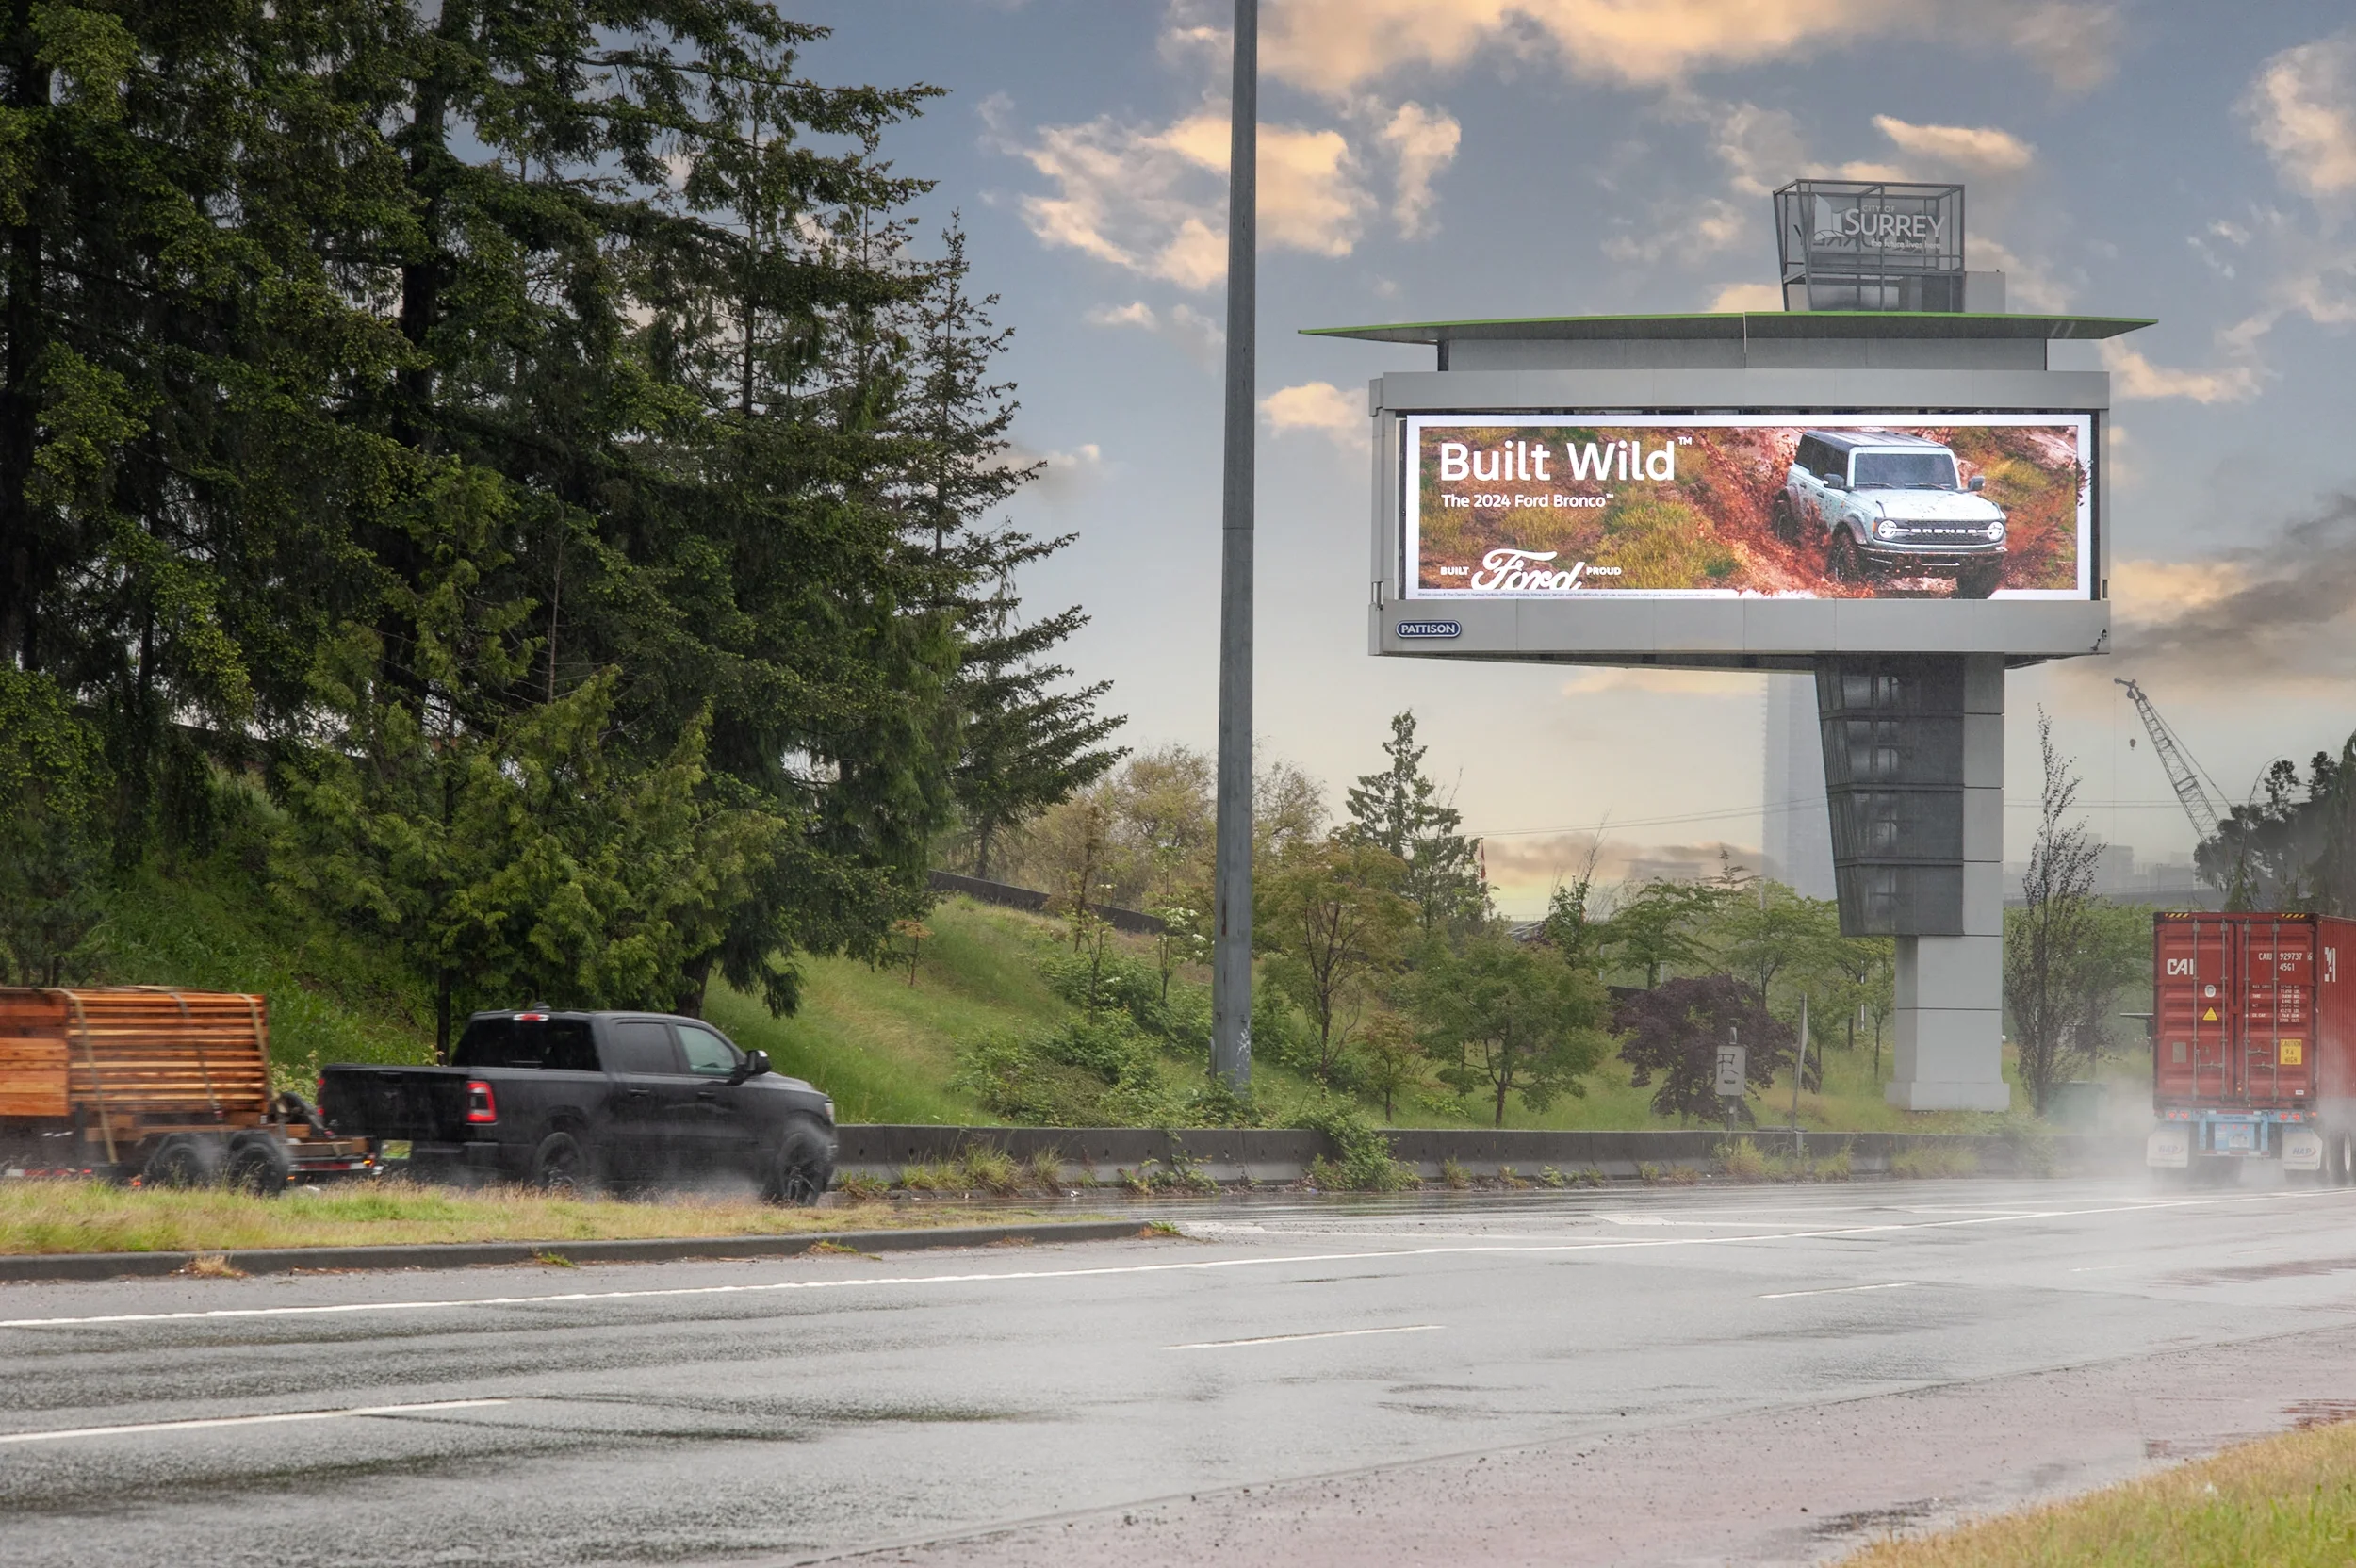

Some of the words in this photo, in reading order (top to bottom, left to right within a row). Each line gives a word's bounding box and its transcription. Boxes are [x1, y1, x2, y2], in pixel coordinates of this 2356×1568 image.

[1845, 208, 1945, 237] SURREY
[1884, 239, 1905, 248] future
[1906, 240, 1922, 249] lives
[1440, 440, 1551, 482] Built
[1441, 494, 1470, 508] The
[1473, 494, 1511, 508] 2024
[1514, 493, 1549, 508] Ford
[1440, 566, 1469, 576] BUILT
[1471, 548, 1586, 590] Ford
[1586, 566, 1622, 576] PROUD
[1401, 624, 1456, 635] PATTISON
[2279, 952, 2303, 961] 929737
[2167, 958, 2194, 975] CAI
[2280, 962, 2295, 972] 45G1
